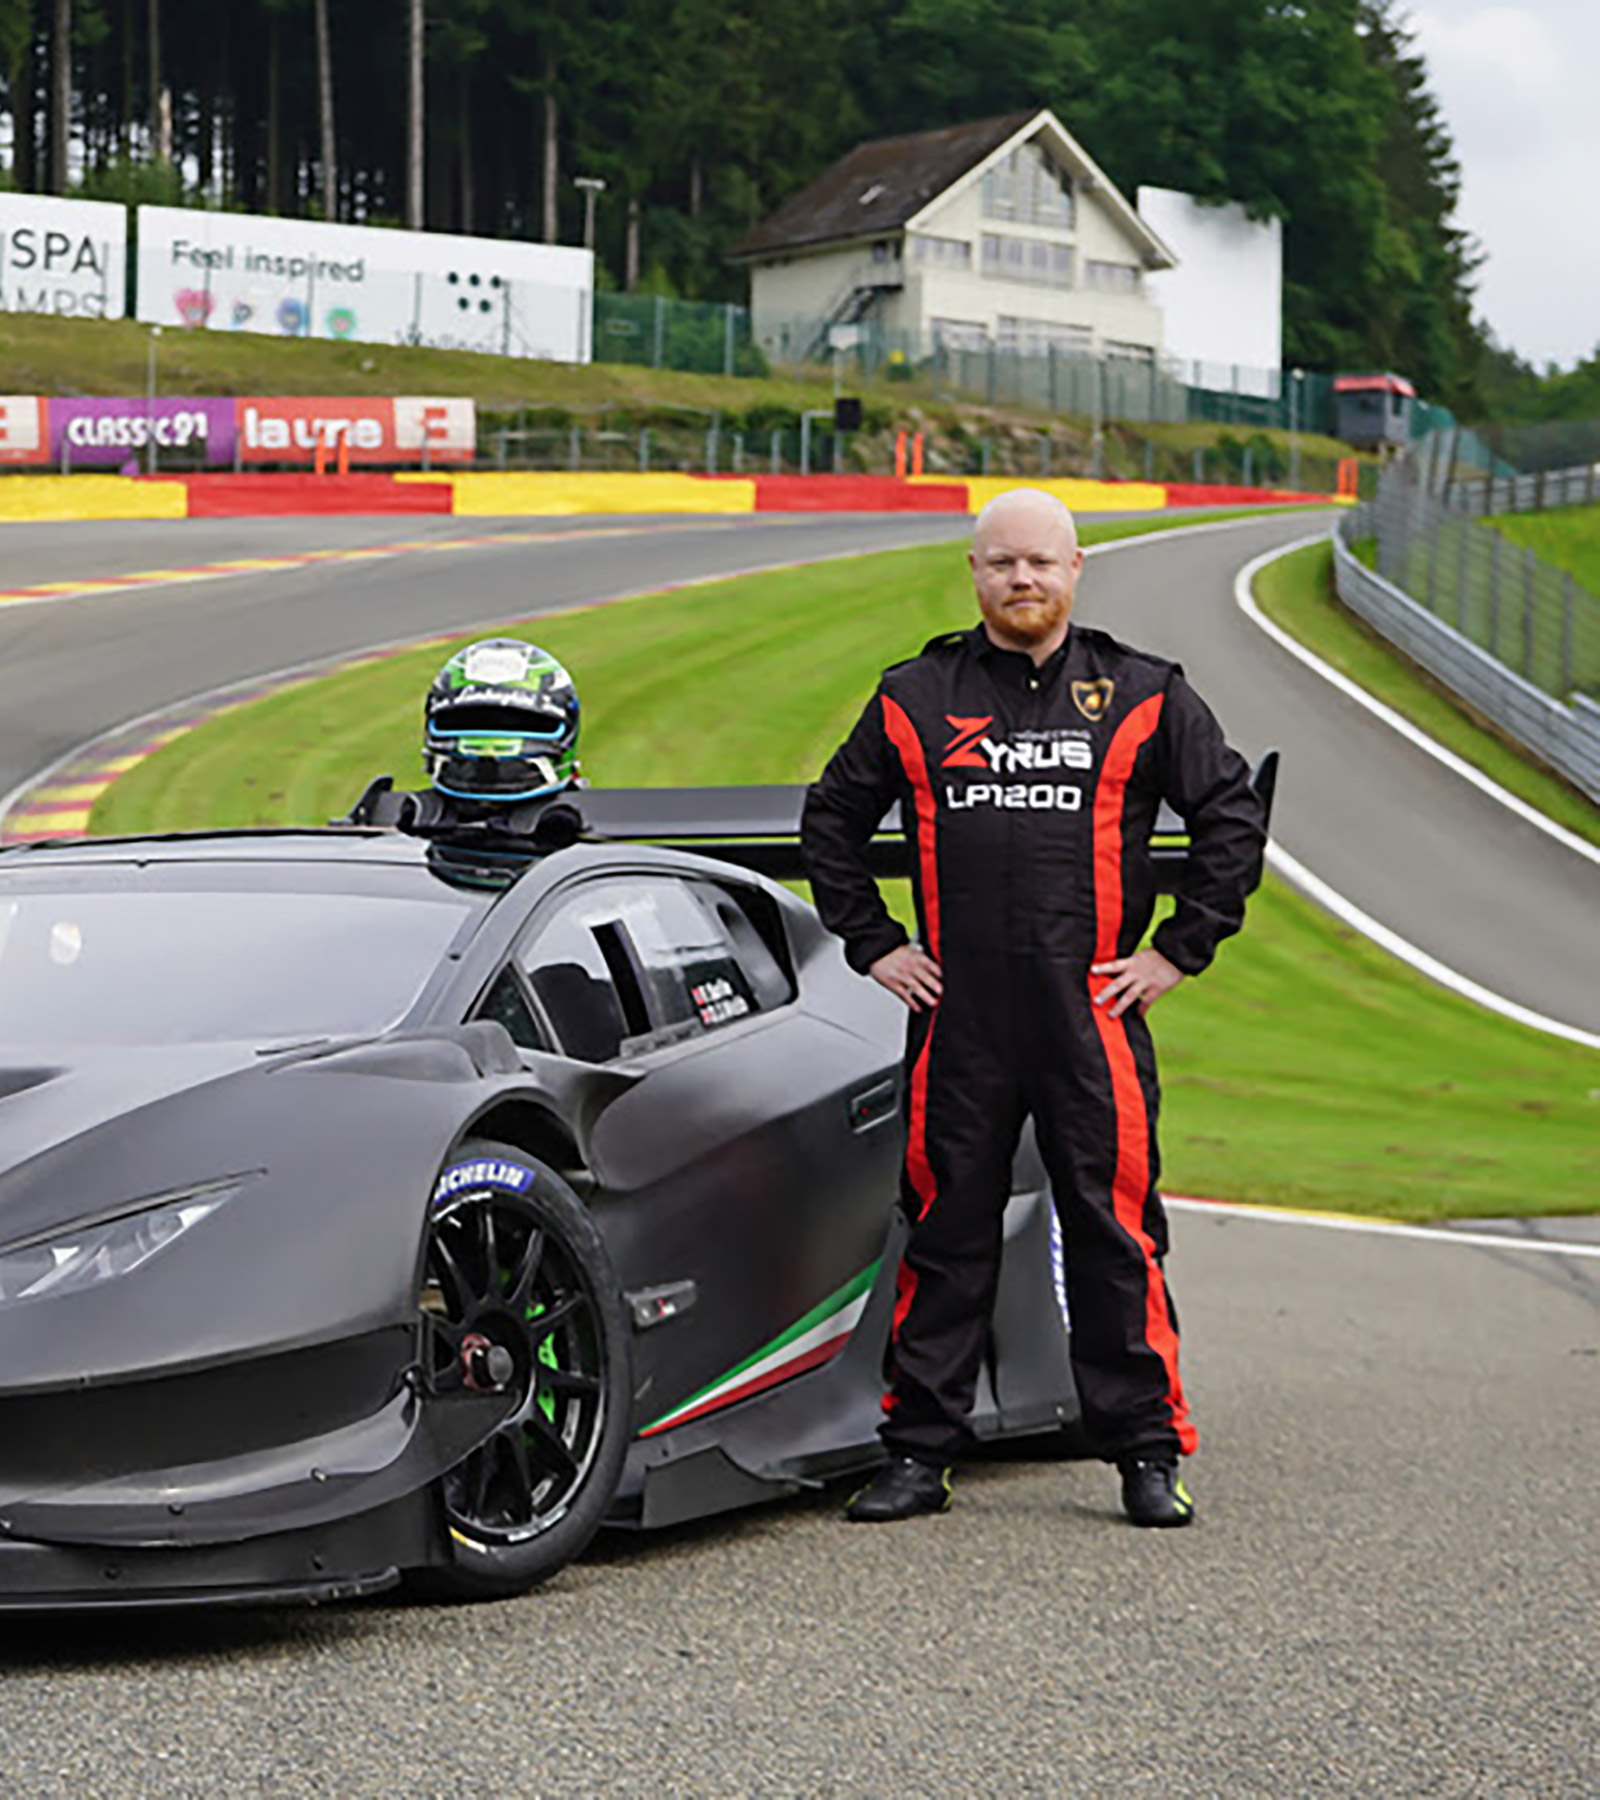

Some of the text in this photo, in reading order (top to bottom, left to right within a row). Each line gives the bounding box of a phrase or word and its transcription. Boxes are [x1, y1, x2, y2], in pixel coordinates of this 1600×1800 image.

[11, 228, 103, 277] SPA
[171, 239, 365, 284] Feel inspired
[940, 714, 1093, 774] ZYRUS
[945, 783, 1083, 812] LP1200
